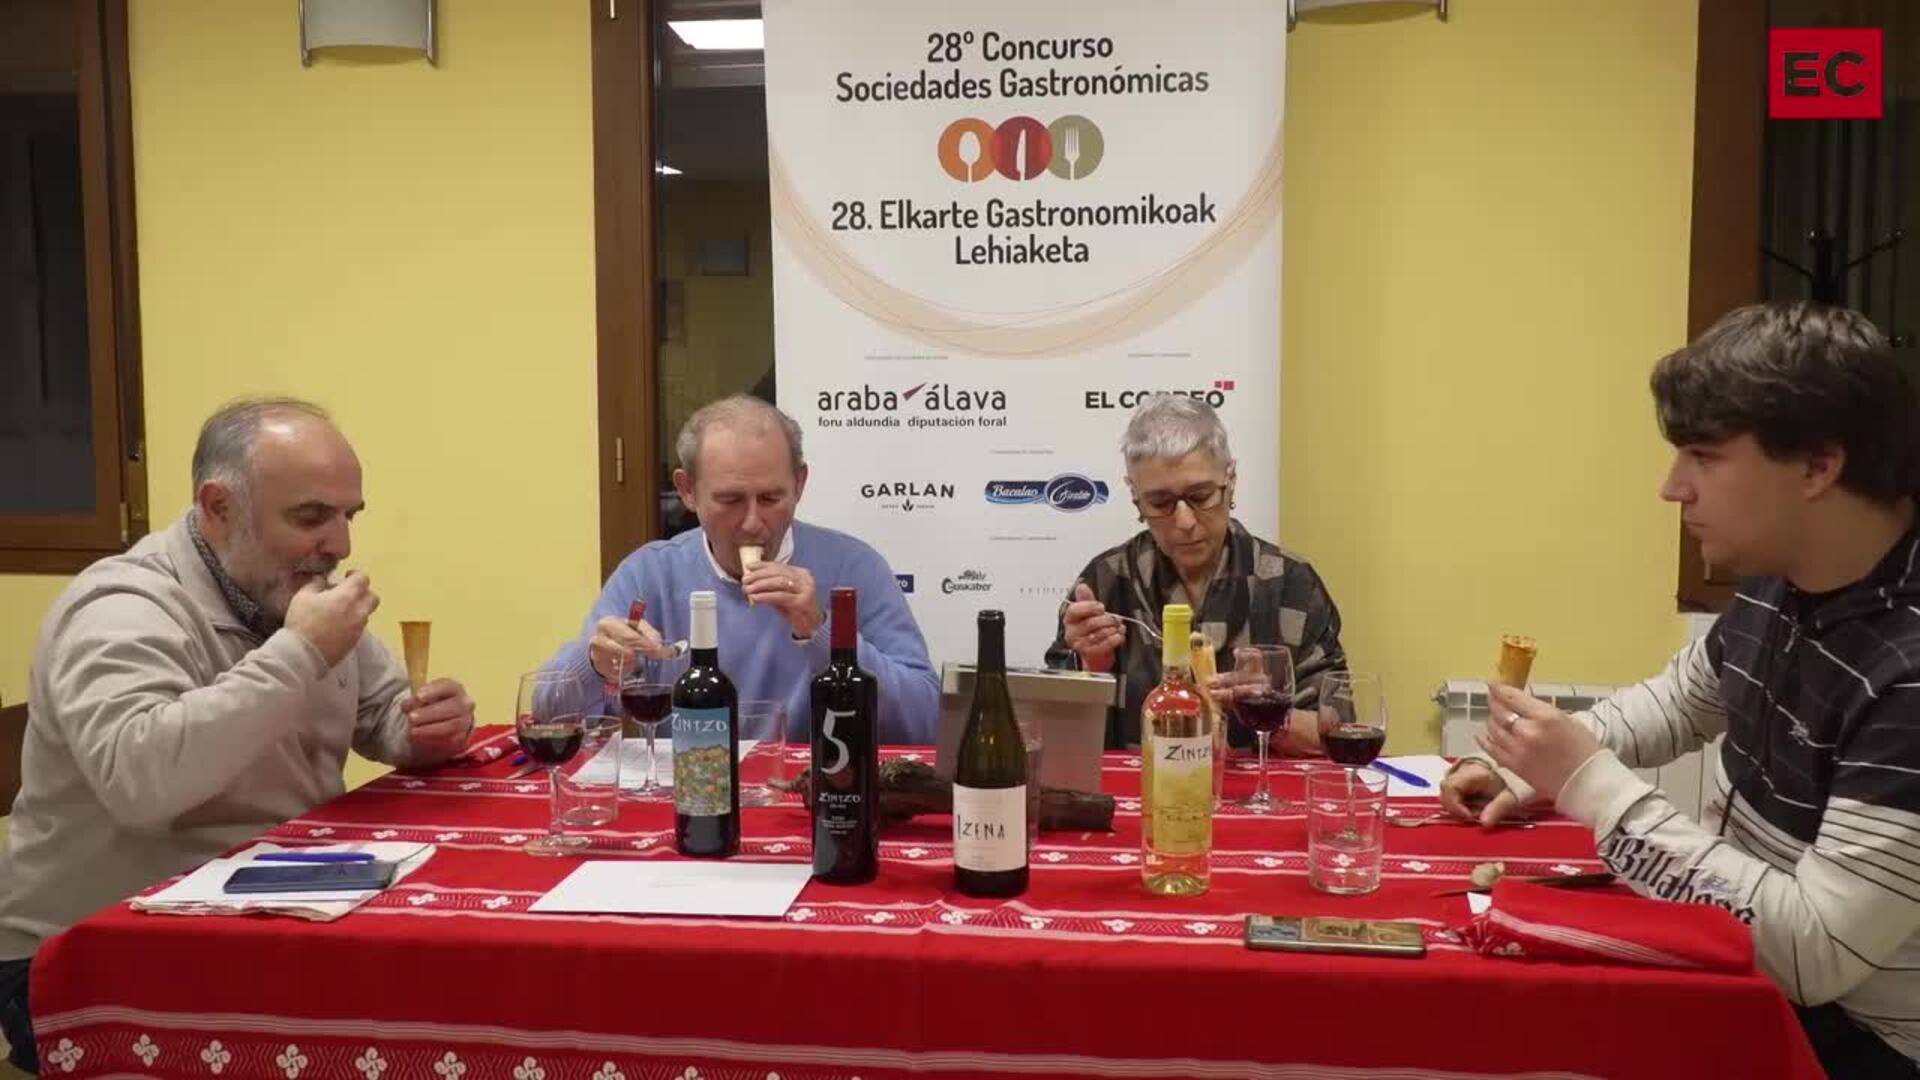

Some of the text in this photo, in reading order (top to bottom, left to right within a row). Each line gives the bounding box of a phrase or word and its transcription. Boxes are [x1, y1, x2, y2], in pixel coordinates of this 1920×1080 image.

[982, 31, 1114, 62] Concurso
[836, 65, 1209, 102] Sociedades Gastronómicas
[831, 192, 1216, 231] 28. Elkarte Gastronomikoak
[955, 234, 1089, 265] Lehiaketa
[818, 384, 1006, 411] araba álava
[1085, 391, 1115, 409] EL
[818, 416, 1007, 429] foru aldundia diputación foral
[861, 482, 955, 498] GARLAN
[821, 708, 856, 774] 5
